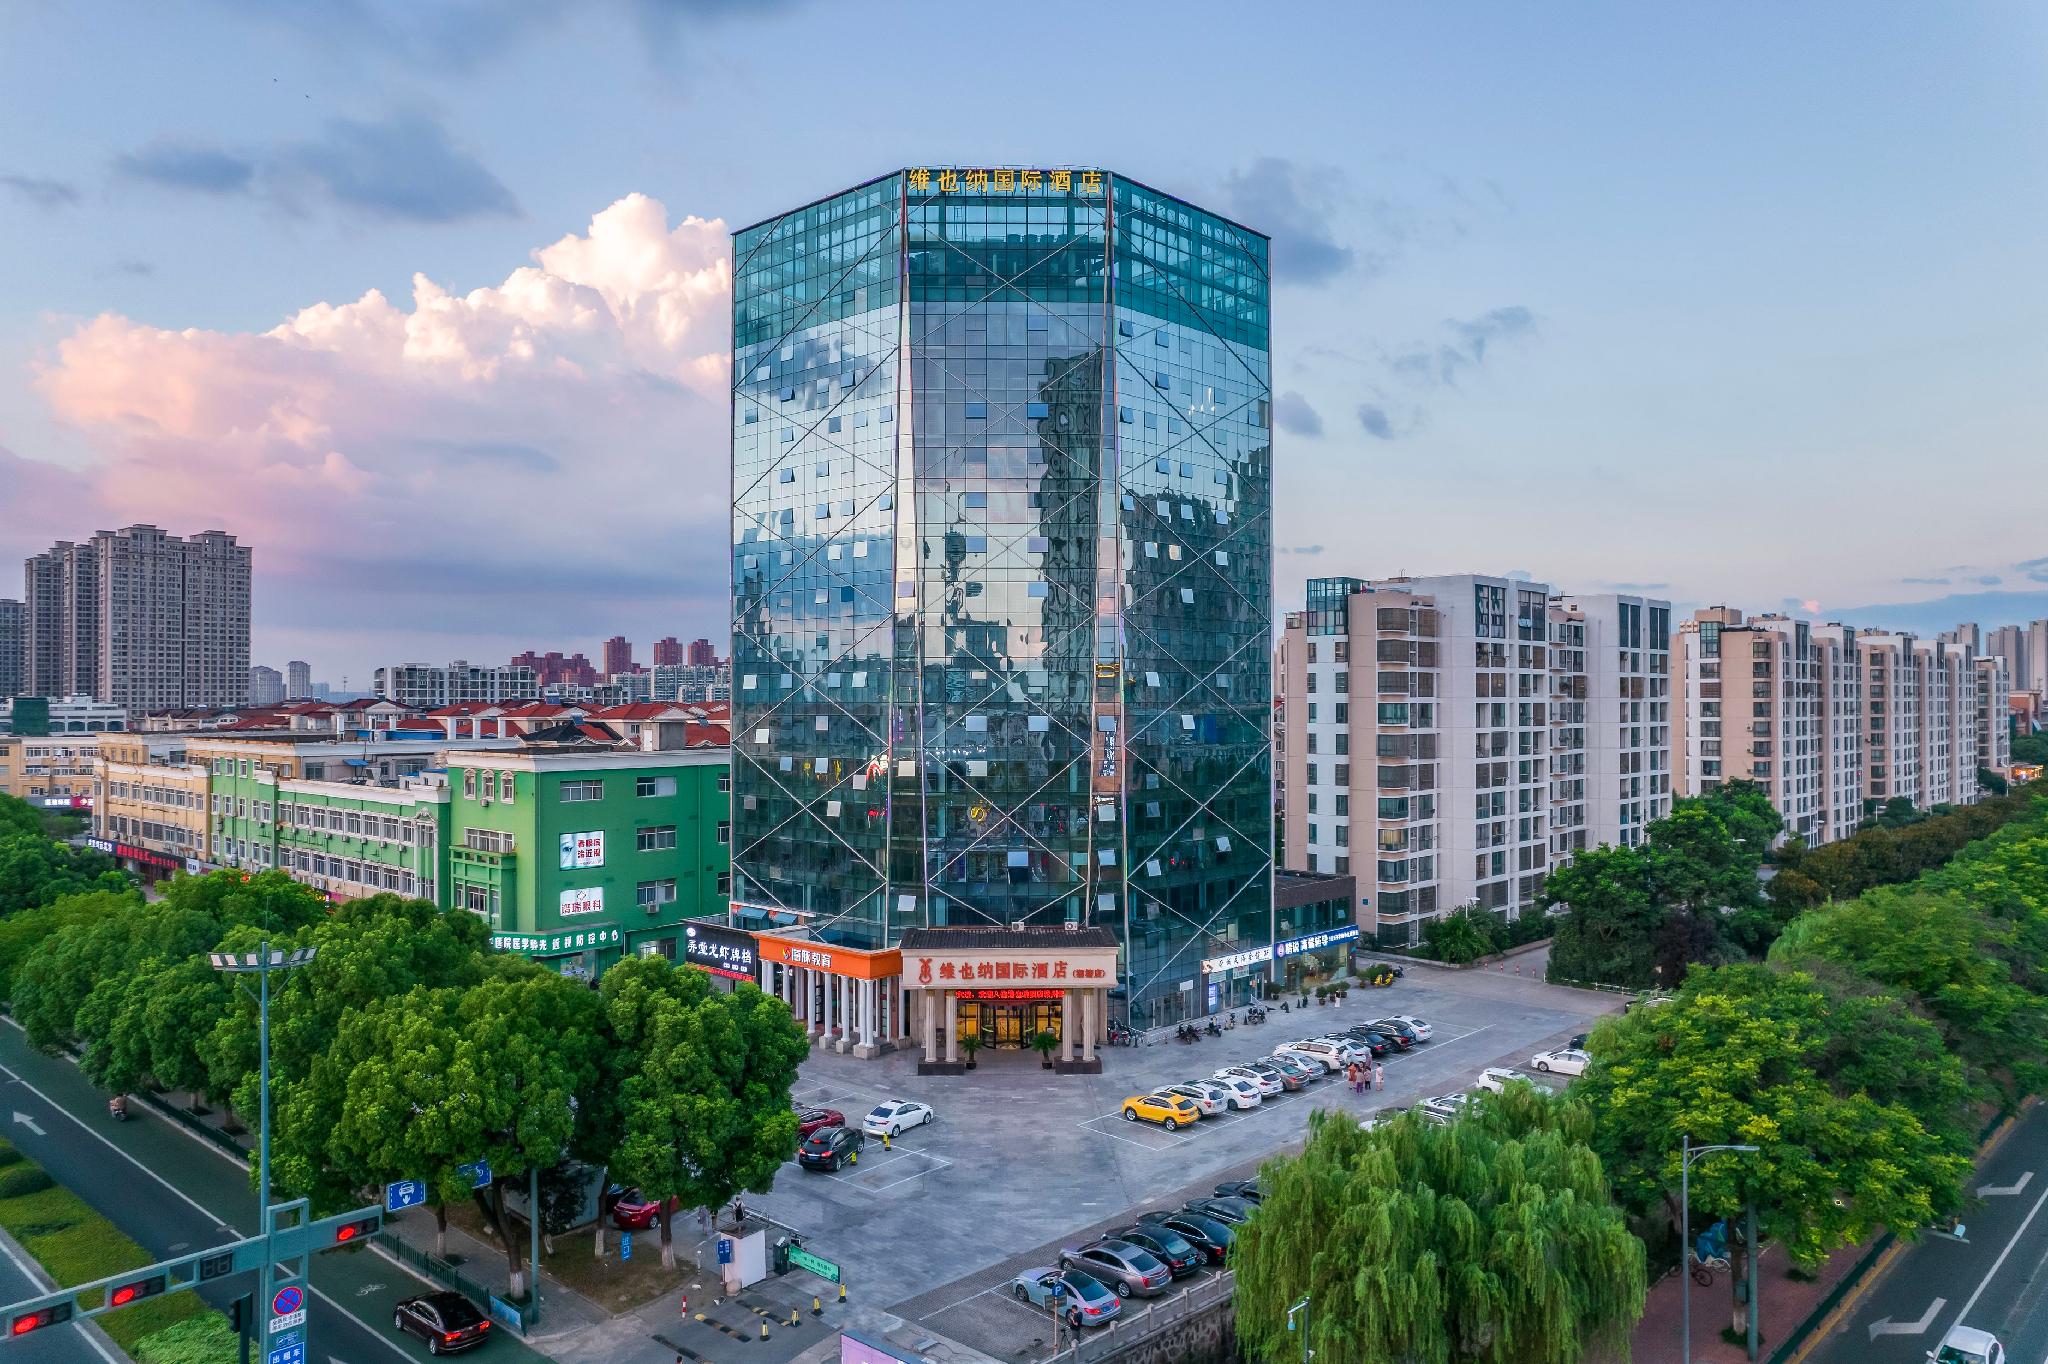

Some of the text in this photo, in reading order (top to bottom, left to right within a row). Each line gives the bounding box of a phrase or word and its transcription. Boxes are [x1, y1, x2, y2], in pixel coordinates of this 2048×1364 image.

[909, 168, 1102, 194] 维也纳国际酒店
[939, 961, 1068, 979] 维也纳国际酒店
[273, 1349, 301, 1363] 出租车
